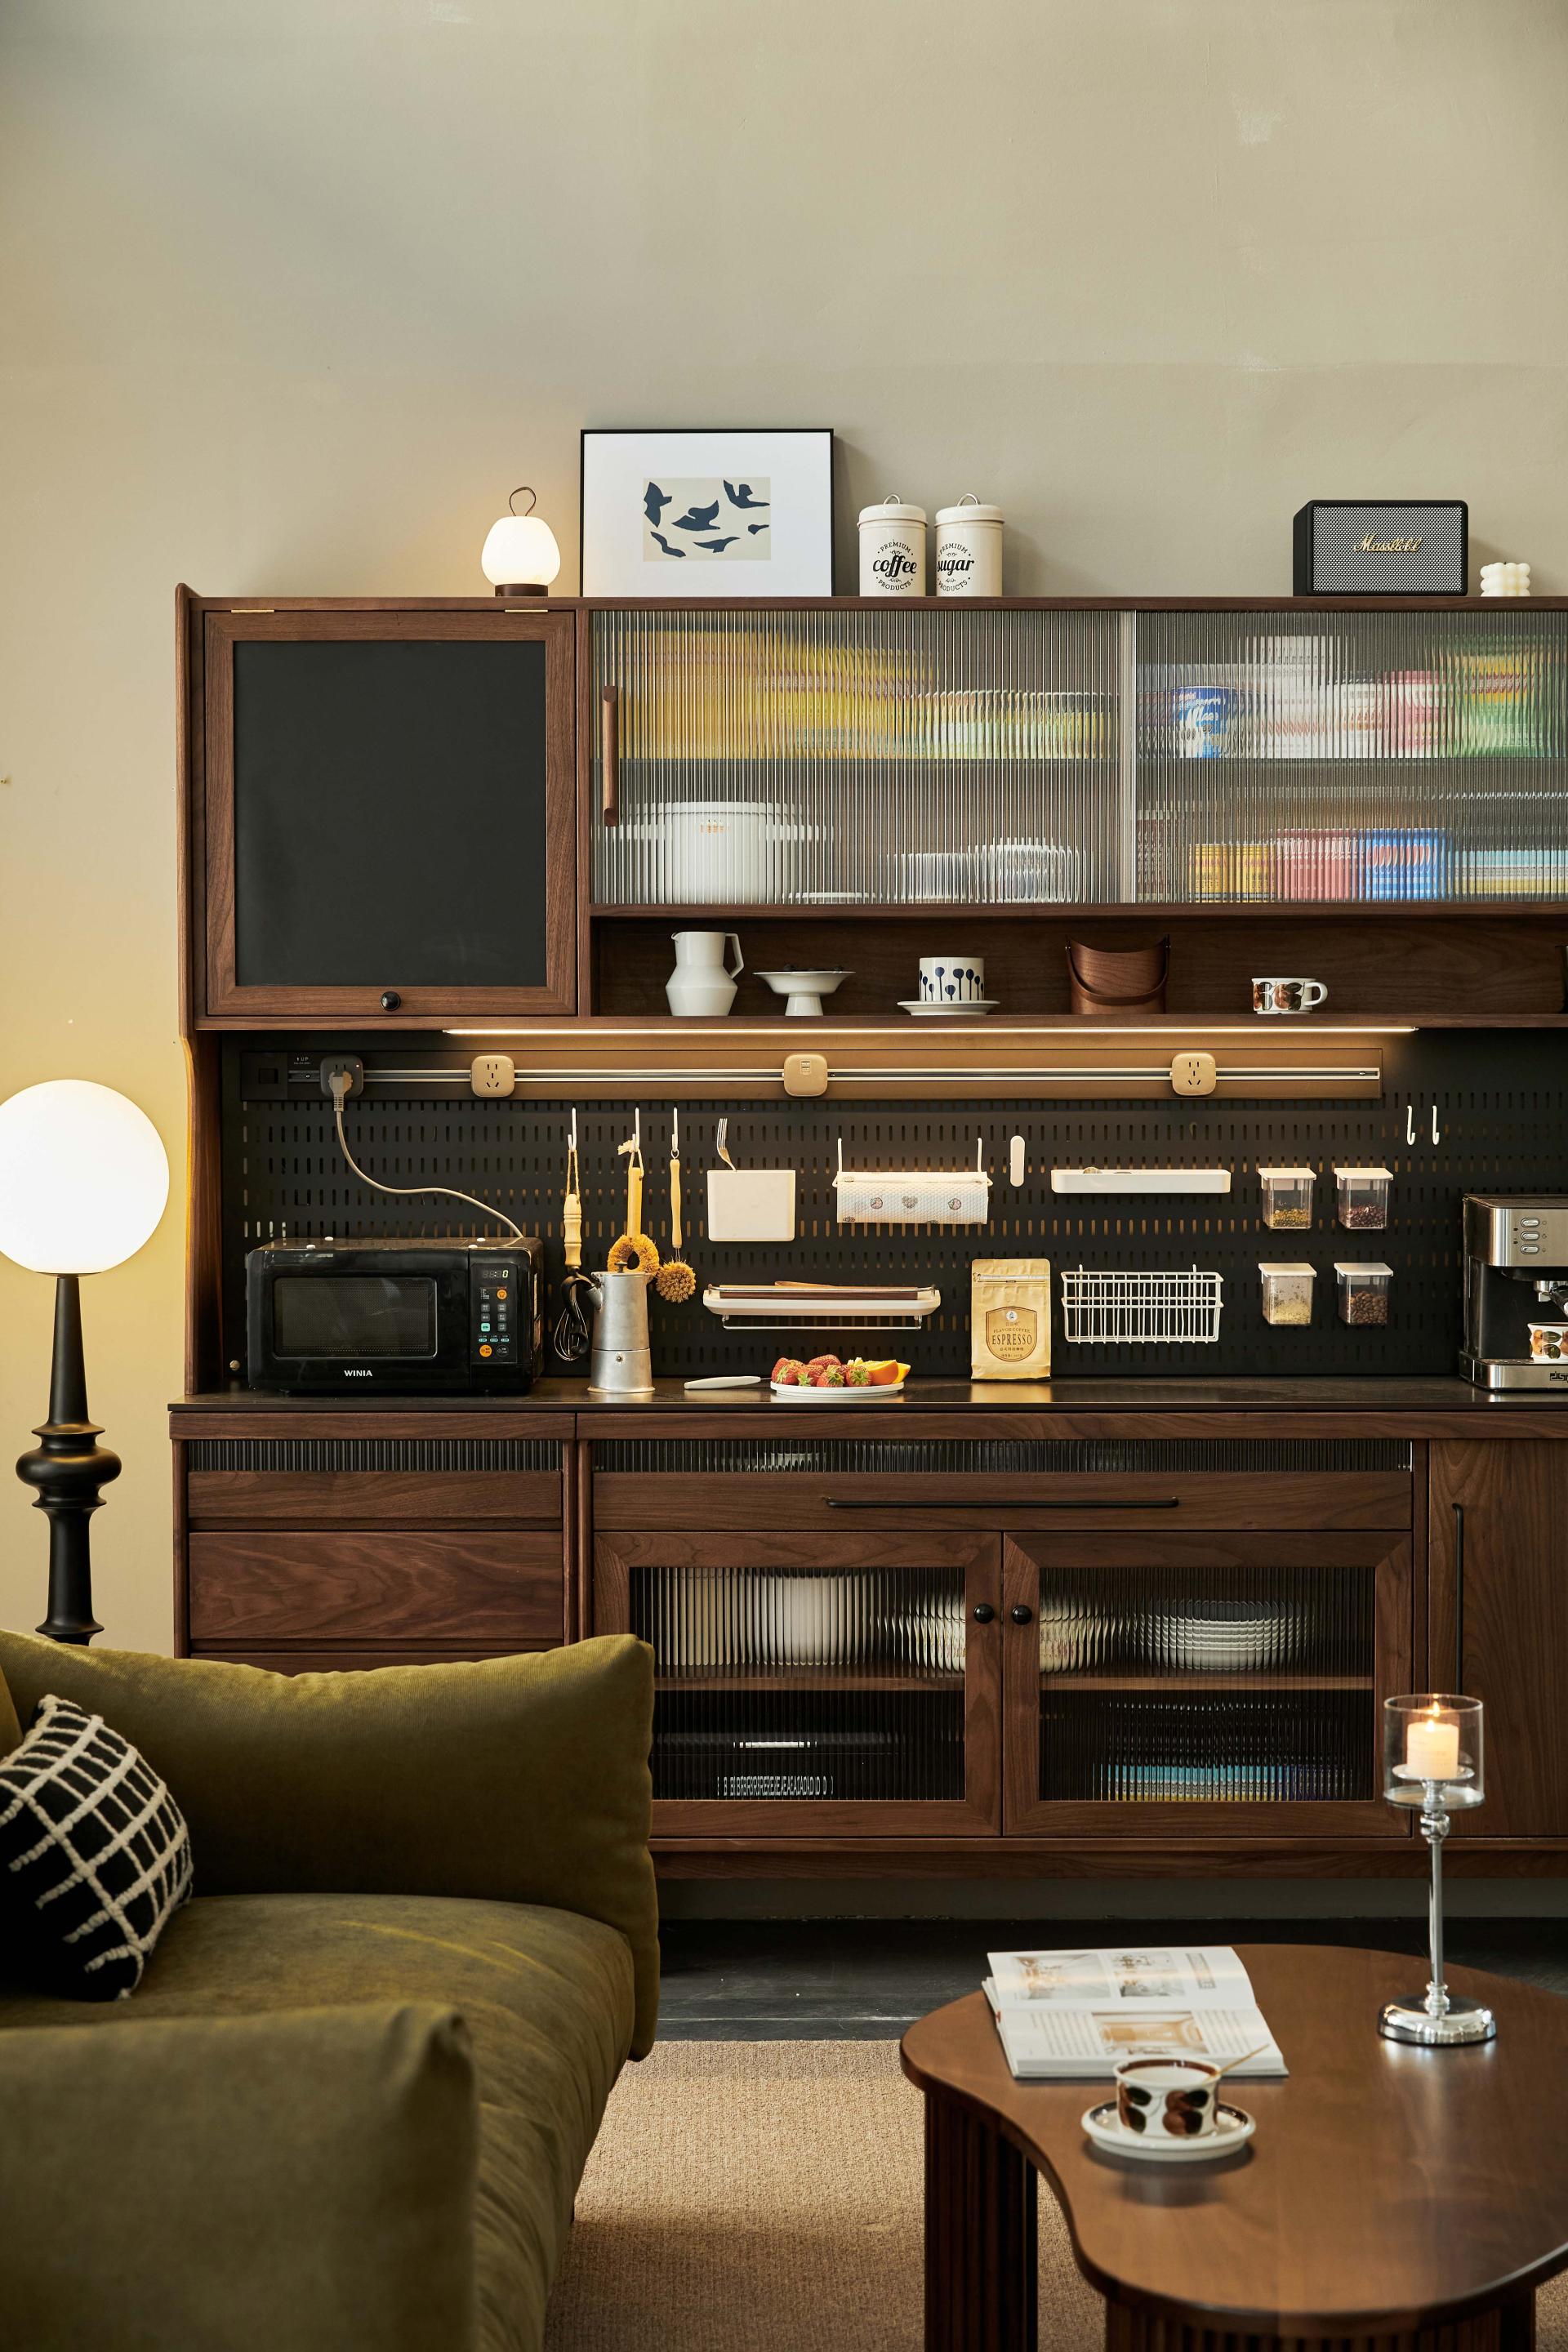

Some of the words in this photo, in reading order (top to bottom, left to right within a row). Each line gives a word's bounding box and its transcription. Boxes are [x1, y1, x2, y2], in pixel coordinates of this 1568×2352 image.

[880, 541, 911, 553] PREMIUM
[872, 555, 917, 578] coffee
[878, 579, 911, 590] PRODUCTS
[992, 1334, 1031, 1345] ESPRESSO
